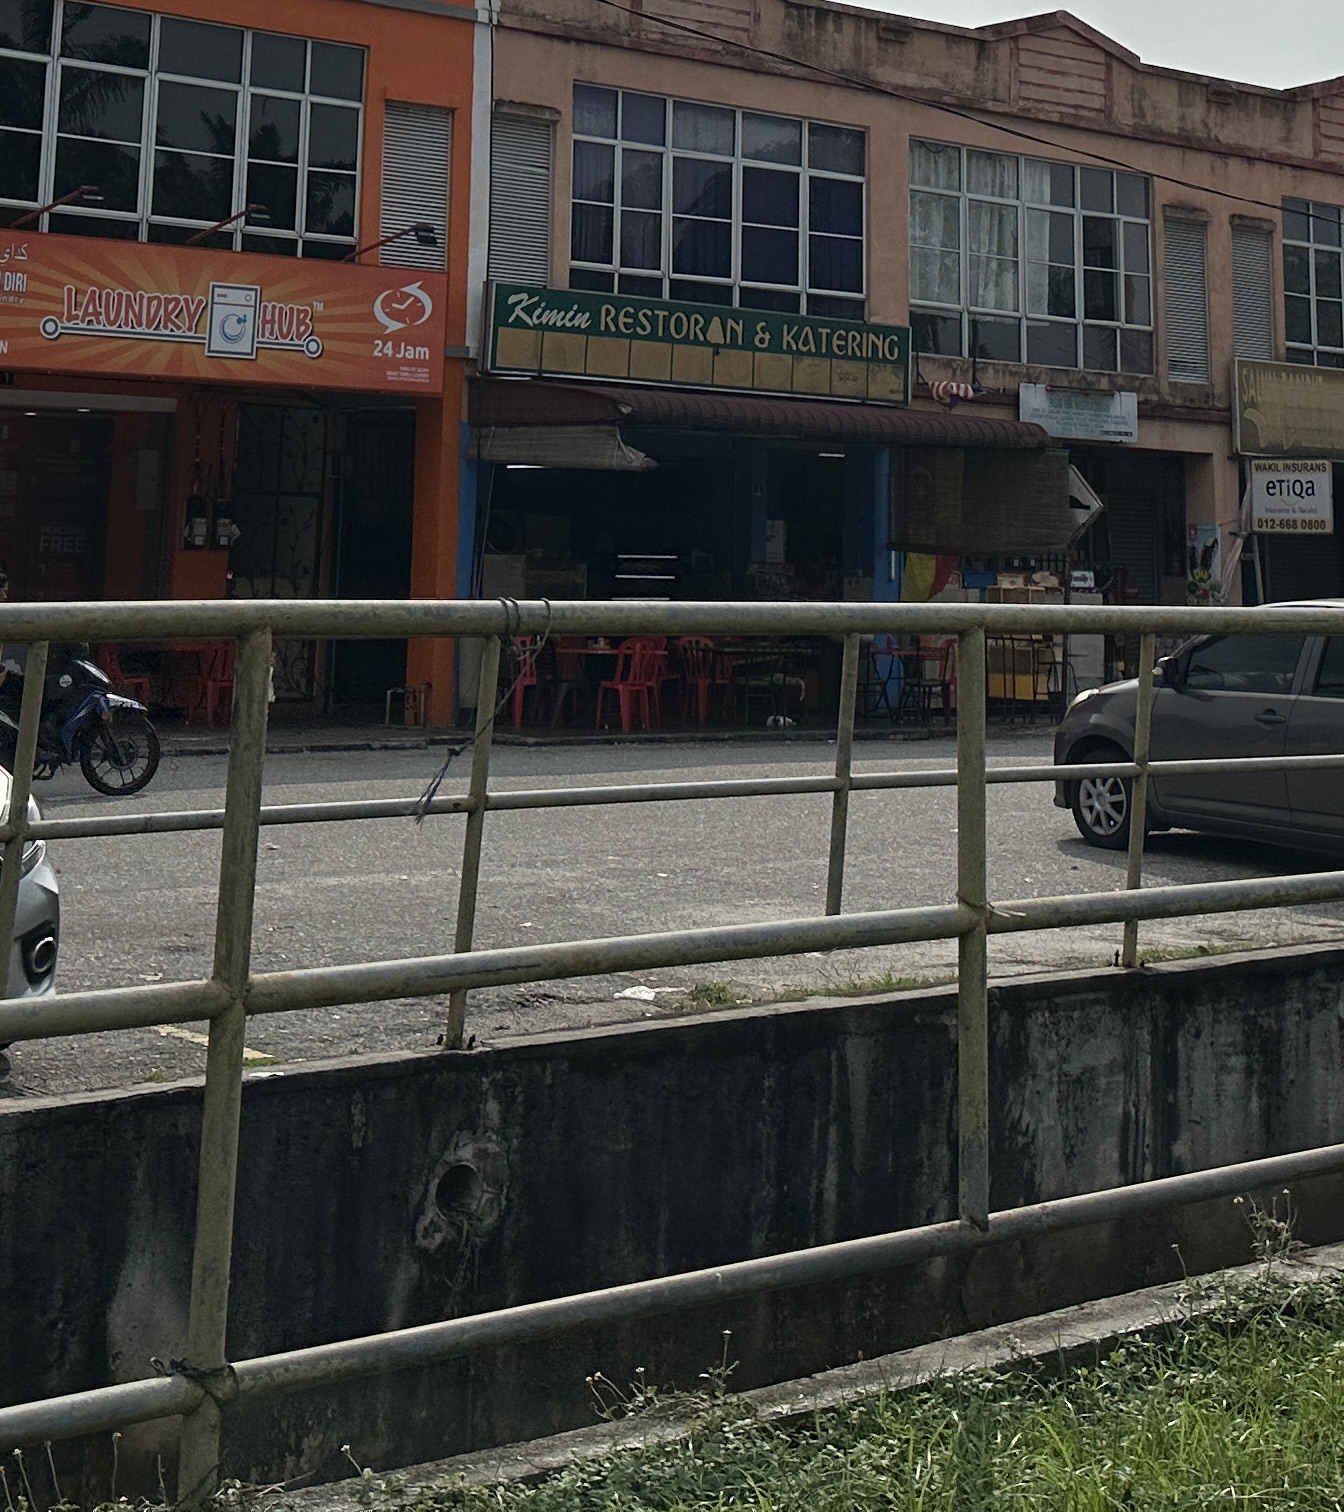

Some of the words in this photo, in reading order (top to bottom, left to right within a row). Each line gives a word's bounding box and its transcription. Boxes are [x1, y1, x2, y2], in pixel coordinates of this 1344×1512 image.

[4, 272, 28, 293] DIRI
[63, 284, 206, 334] LAUNDRY
[258, 301, 313, 341] HUB
[506, 292, 592, 330] Kimin
[599, 304, 745, 346] RESTORAN
[754, 323, 771, 348] &
[781, 324, 900, 361] KATERING
[373, 339, 393, 357] 24
[395, 341, 430, 360] Jam
[1253, 462, 1281, 472] WAKIL
[1283, 462, 1327, 473] INSURANS
[1257, 518, 1298, 530] 012-668
[1300, 519, 1326, 530] 0800
[39, 536, 86, 553] FREE
